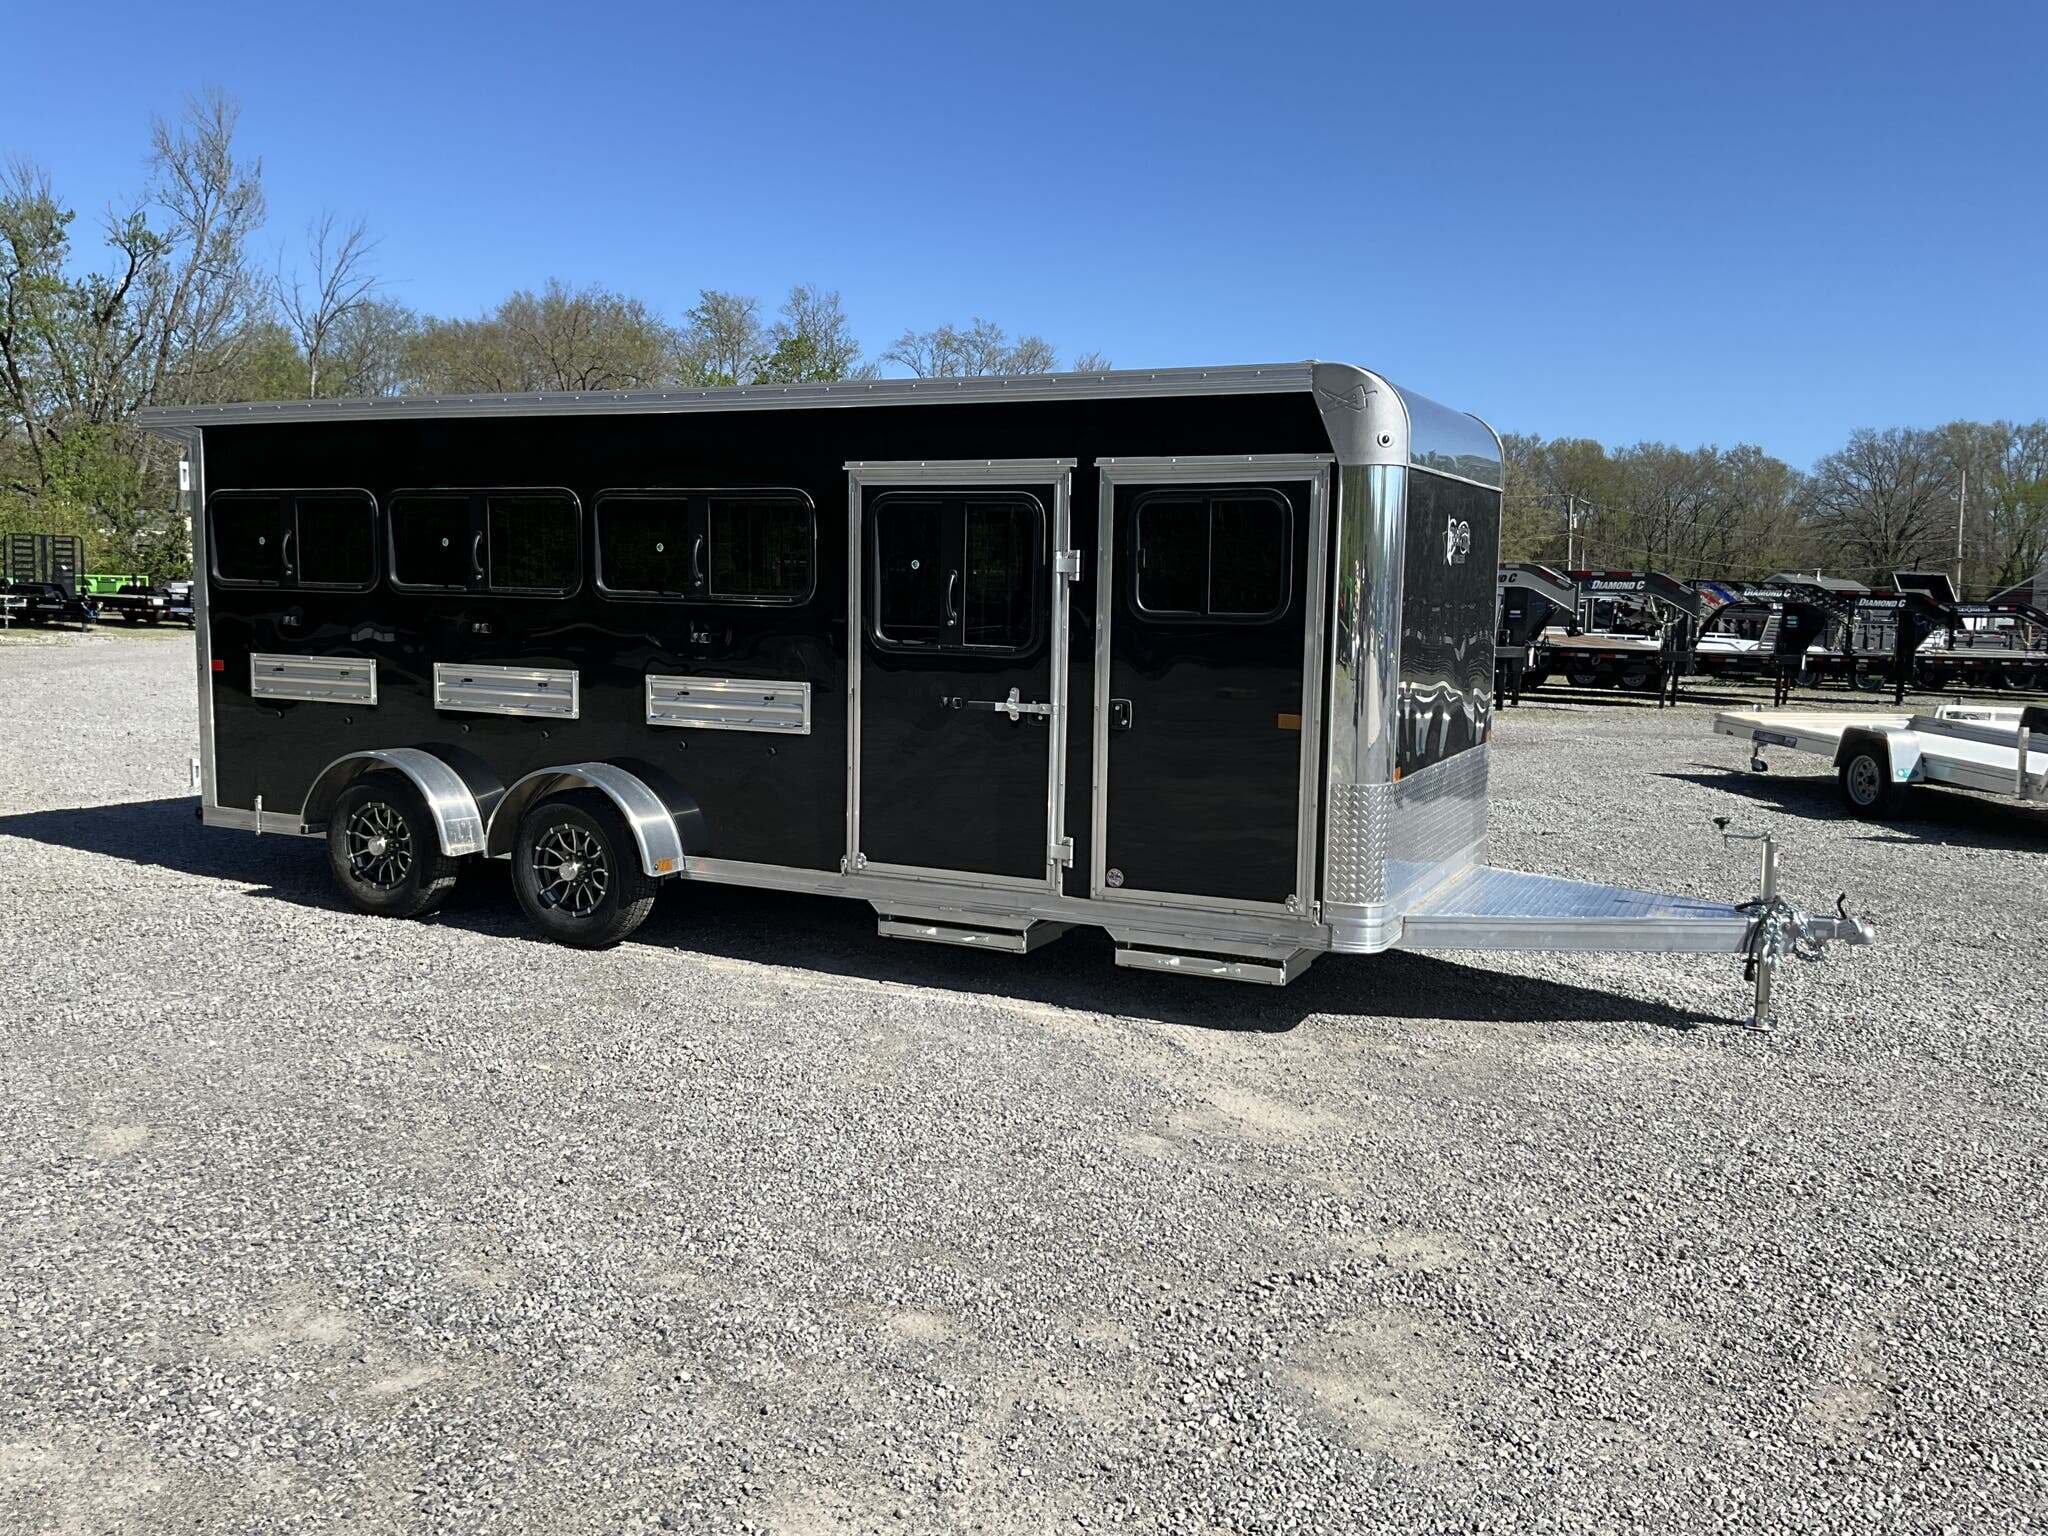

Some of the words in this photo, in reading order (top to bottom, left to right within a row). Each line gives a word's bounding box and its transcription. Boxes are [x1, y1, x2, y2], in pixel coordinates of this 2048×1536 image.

[1591, 580, 1636, 590] DIAMOND
[1636, 580, 1646, 590] C
[1783, 588, 1792, 598] C
[1858, 598, 1898, 608] DIAMOND
[1898, 599, 1906, 608] C
